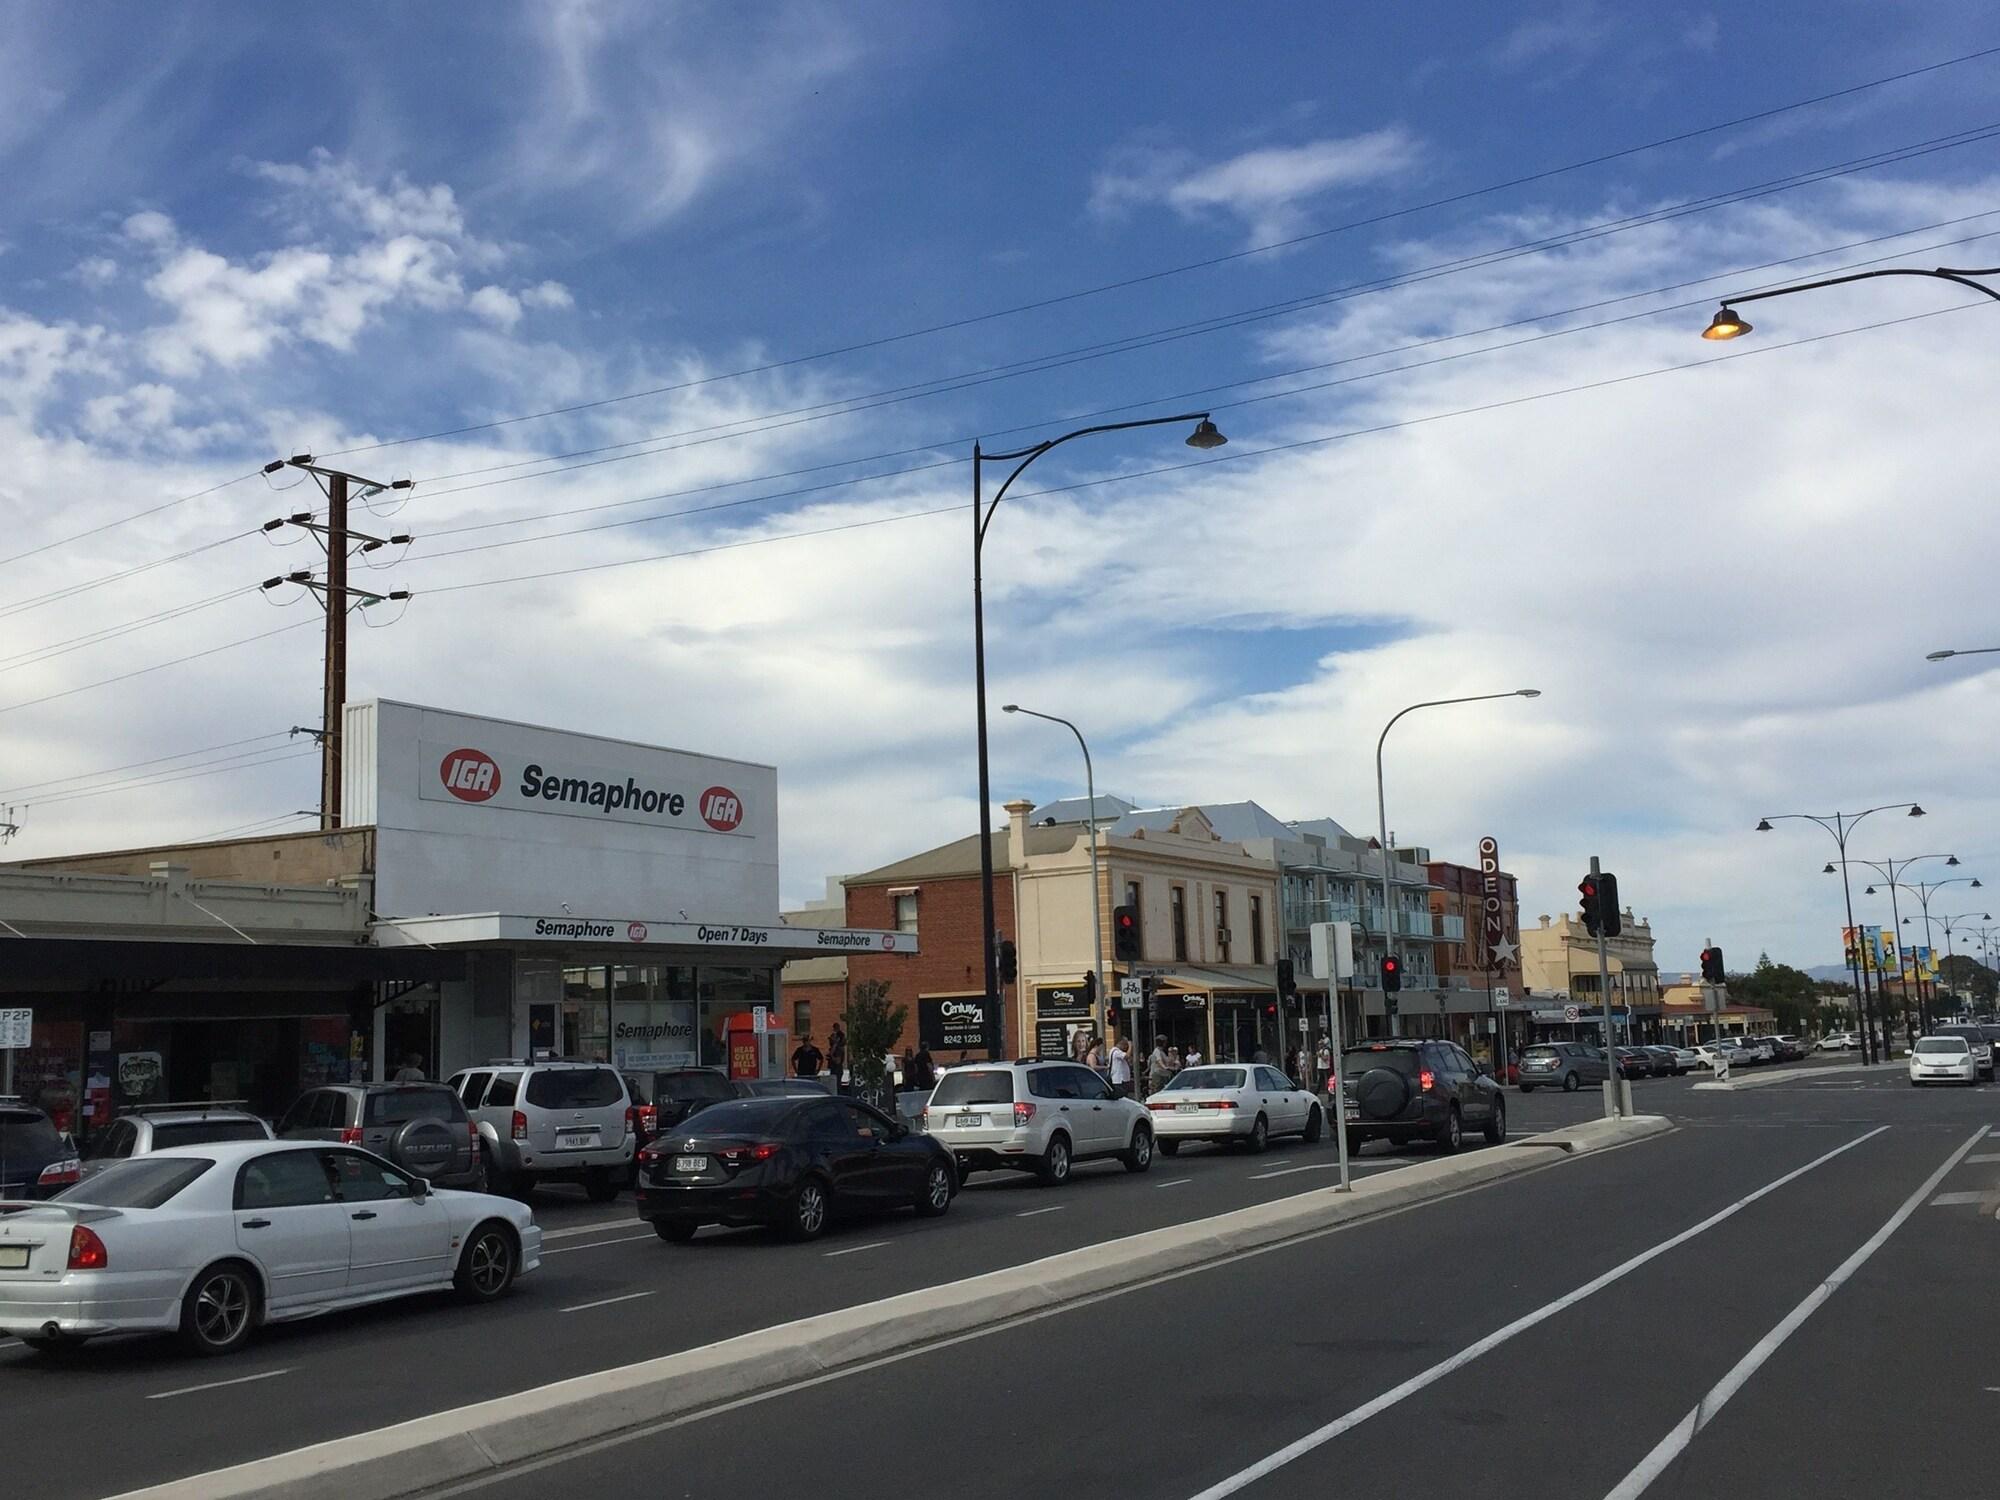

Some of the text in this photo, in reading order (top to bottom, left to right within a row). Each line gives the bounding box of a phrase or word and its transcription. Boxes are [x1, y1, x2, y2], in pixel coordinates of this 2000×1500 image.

[446, 758, 495, 792] IGA
[520, 764, 685, 816] Semaphore
[704, 794, 738, 823] IGA
[1480, 838, 1501, 932] ODEON
[535, 919, 614, 939] Semaphore
[698, 926, 768, 944] Open 7 Days
[817, 932, 870, 947] Semaphore
[1123, 997, 1141, 1005] LANE
[13, 1010, 31, 1020] 2P
[941, 1001, 984, 1023] Century 21
[616, 1021, 692, 1040] Semaphore
[943, 1034, 982, 1044] 8242 1233
